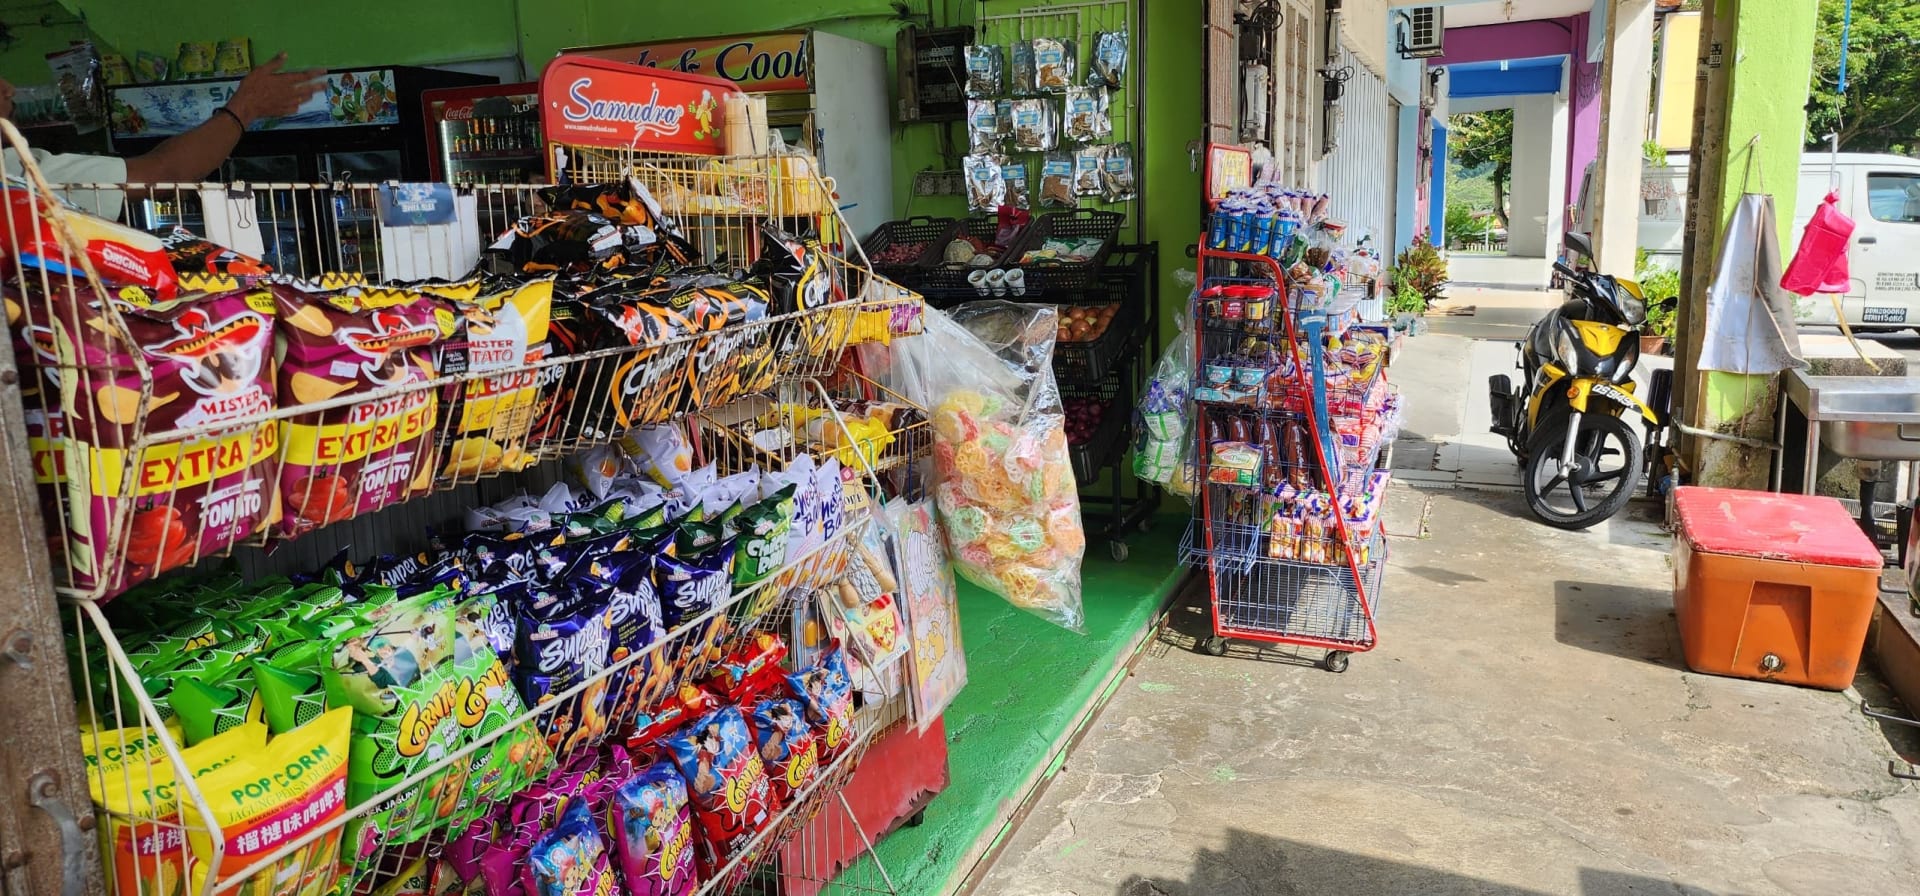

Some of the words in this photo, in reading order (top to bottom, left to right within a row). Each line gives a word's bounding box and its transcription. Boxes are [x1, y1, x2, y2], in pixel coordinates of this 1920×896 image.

[715, 41, 805, 82] Cool
[563, 77, 680, 126] Samudra
[102, 247, 152, 279] ORIGINAL
[467, 349, 513, 364] TATO
[200, 389, 260, 415] MISTER
[317, 419, 399, 461] EXTRA
[140, 440, 244, 489] EXTRA
[231, 777, 272, 806] POP
[273, 744, 330, 787] CORN
